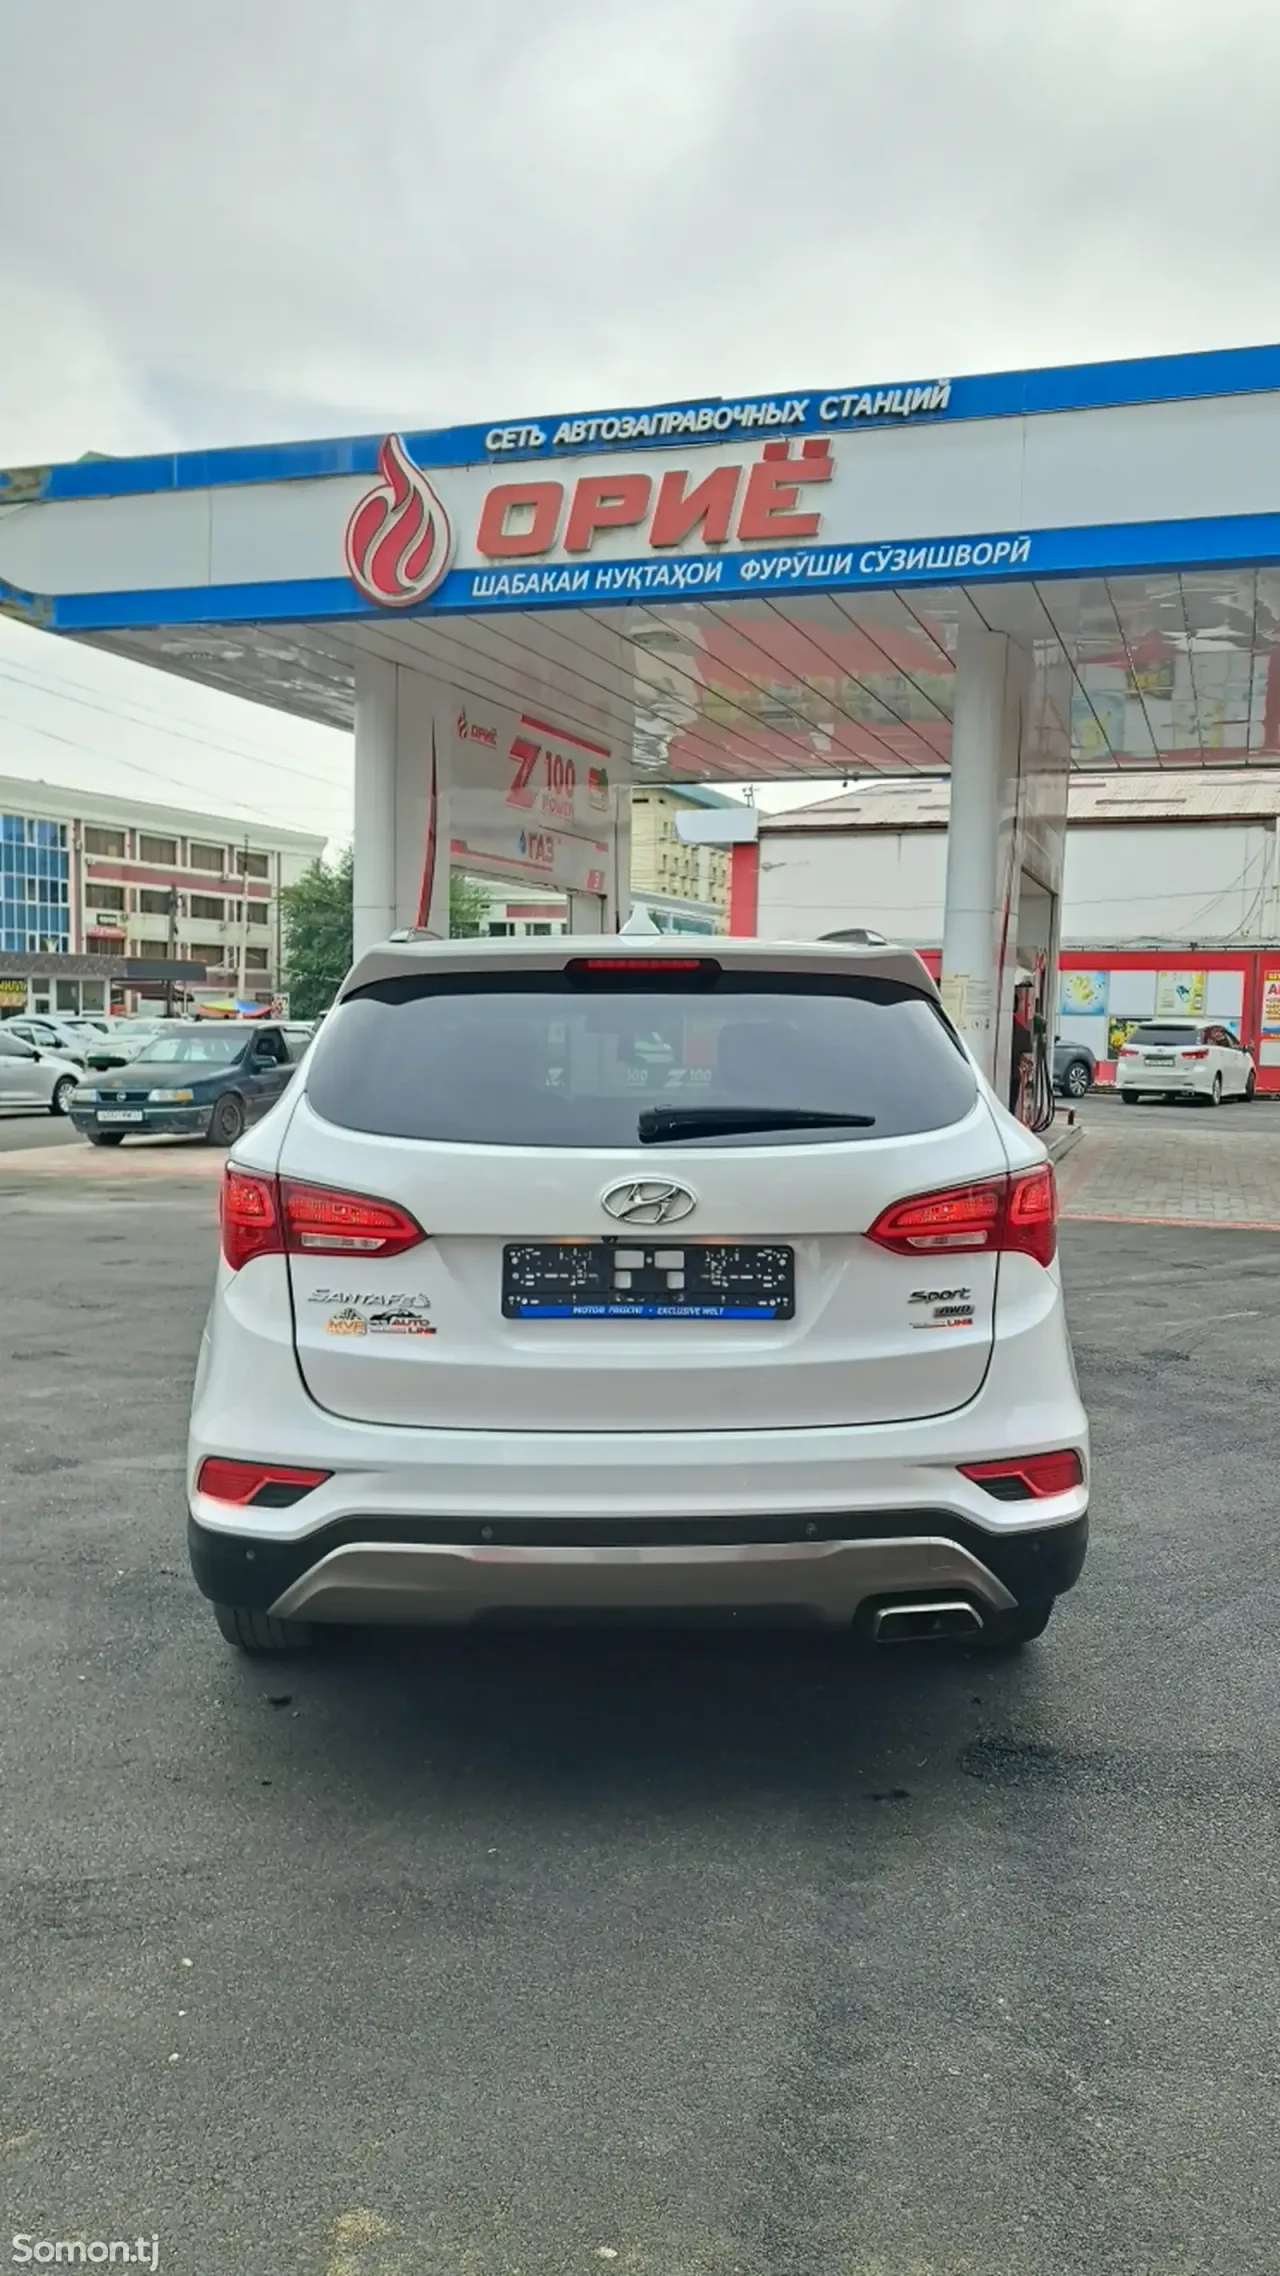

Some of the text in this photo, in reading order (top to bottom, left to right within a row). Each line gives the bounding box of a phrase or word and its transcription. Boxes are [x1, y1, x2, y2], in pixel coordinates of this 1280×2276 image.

[485, 377, 952, 451] СЕТЬ АВТОЗАПРАВОЧНЫХ СТАНЦИЙ
[476, 438, 836, 557] ОРИЁ
[472, 568, 590, 596] ШАБАКАИ
[595, 560, 723, 590] НУҚТАҲОИ
[545, 751, 575, 798] 100
[528, 832, 554, 863] ГАЗ
[907, 1287, 972, 1304] Sport
